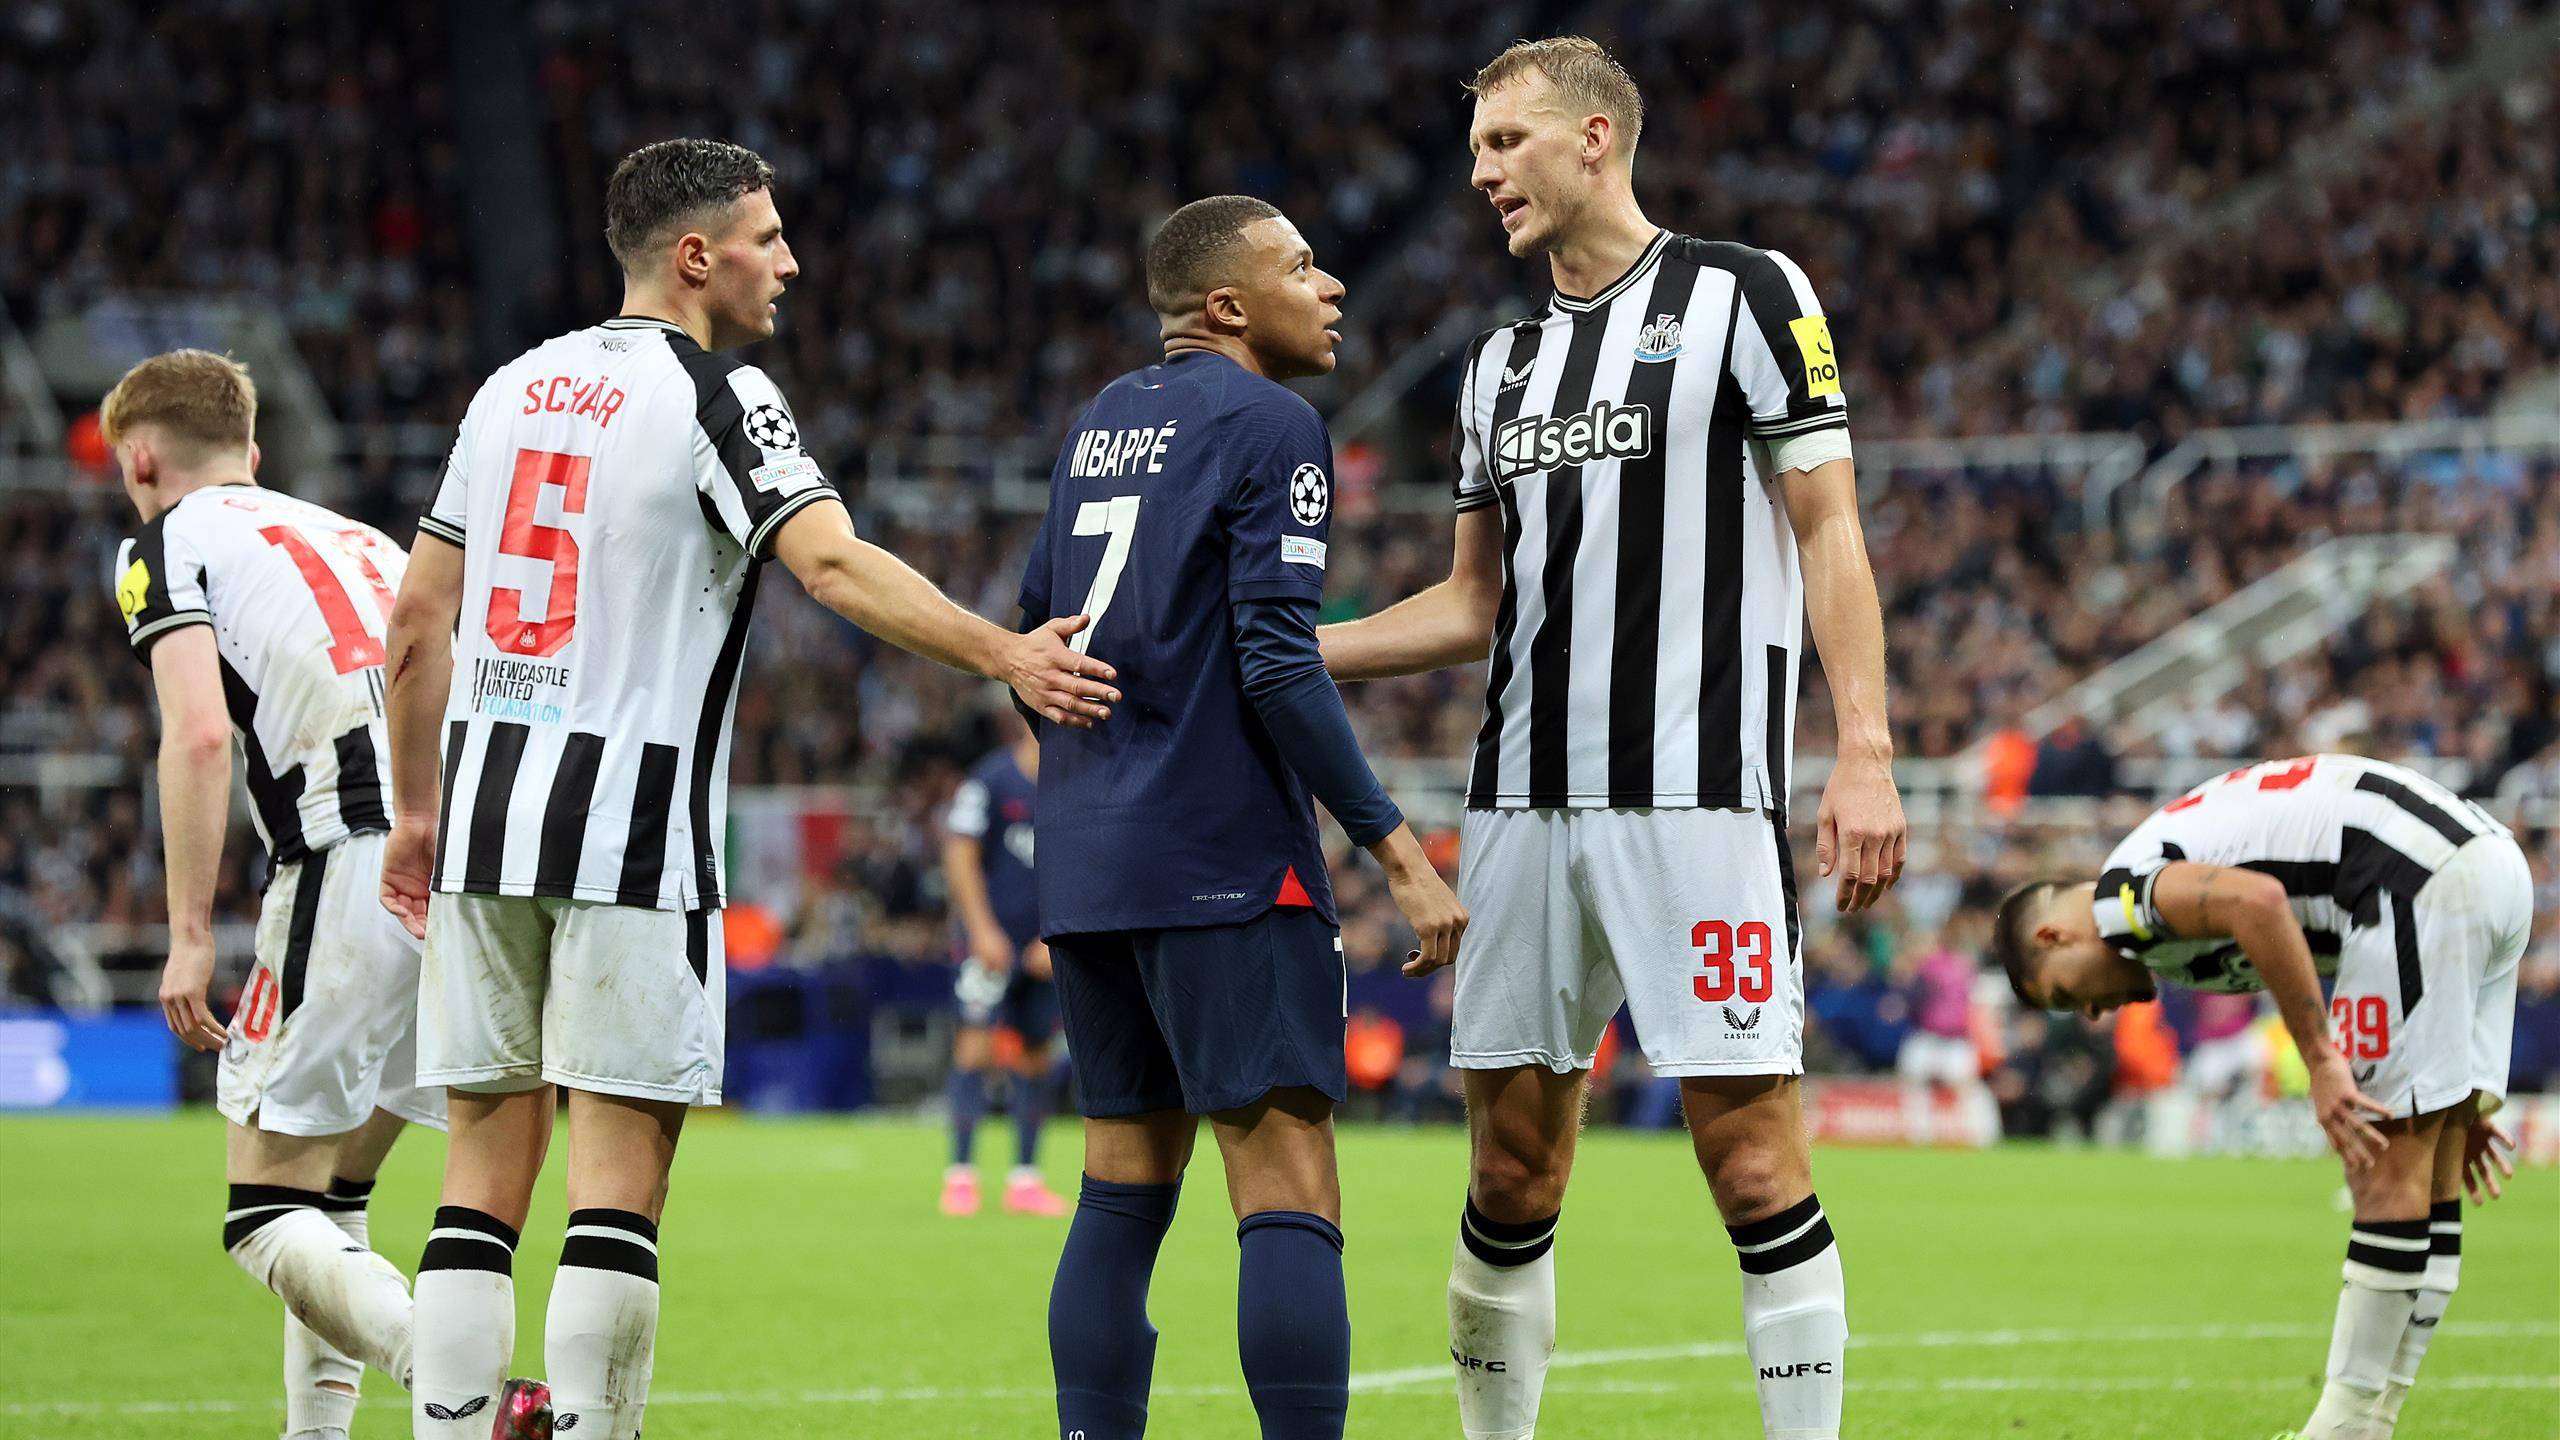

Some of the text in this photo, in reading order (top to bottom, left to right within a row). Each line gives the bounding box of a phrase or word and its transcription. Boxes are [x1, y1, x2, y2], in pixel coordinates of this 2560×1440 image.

[598, 341, 628, 353] NUFC
[523, 375, 625, 429] SCHÄR
[1069, 419, 1178, 478] MBAPPÉ
[1538, 406, 1642, 464] sela
[485, 448, 592, 658] 5
[1069, 495, 1142, 658] 7
[486, 678, 534, 701] UNITED
[490, 658, 570, 688] NEWCASTLE
[1691, 920, 1773, 1003] 33
[2332, 996, 2390, 1060] 39
[1450, 1345, 1507, 1372] NUFC
[1760, 1362, 1833, 1380] NUFC
